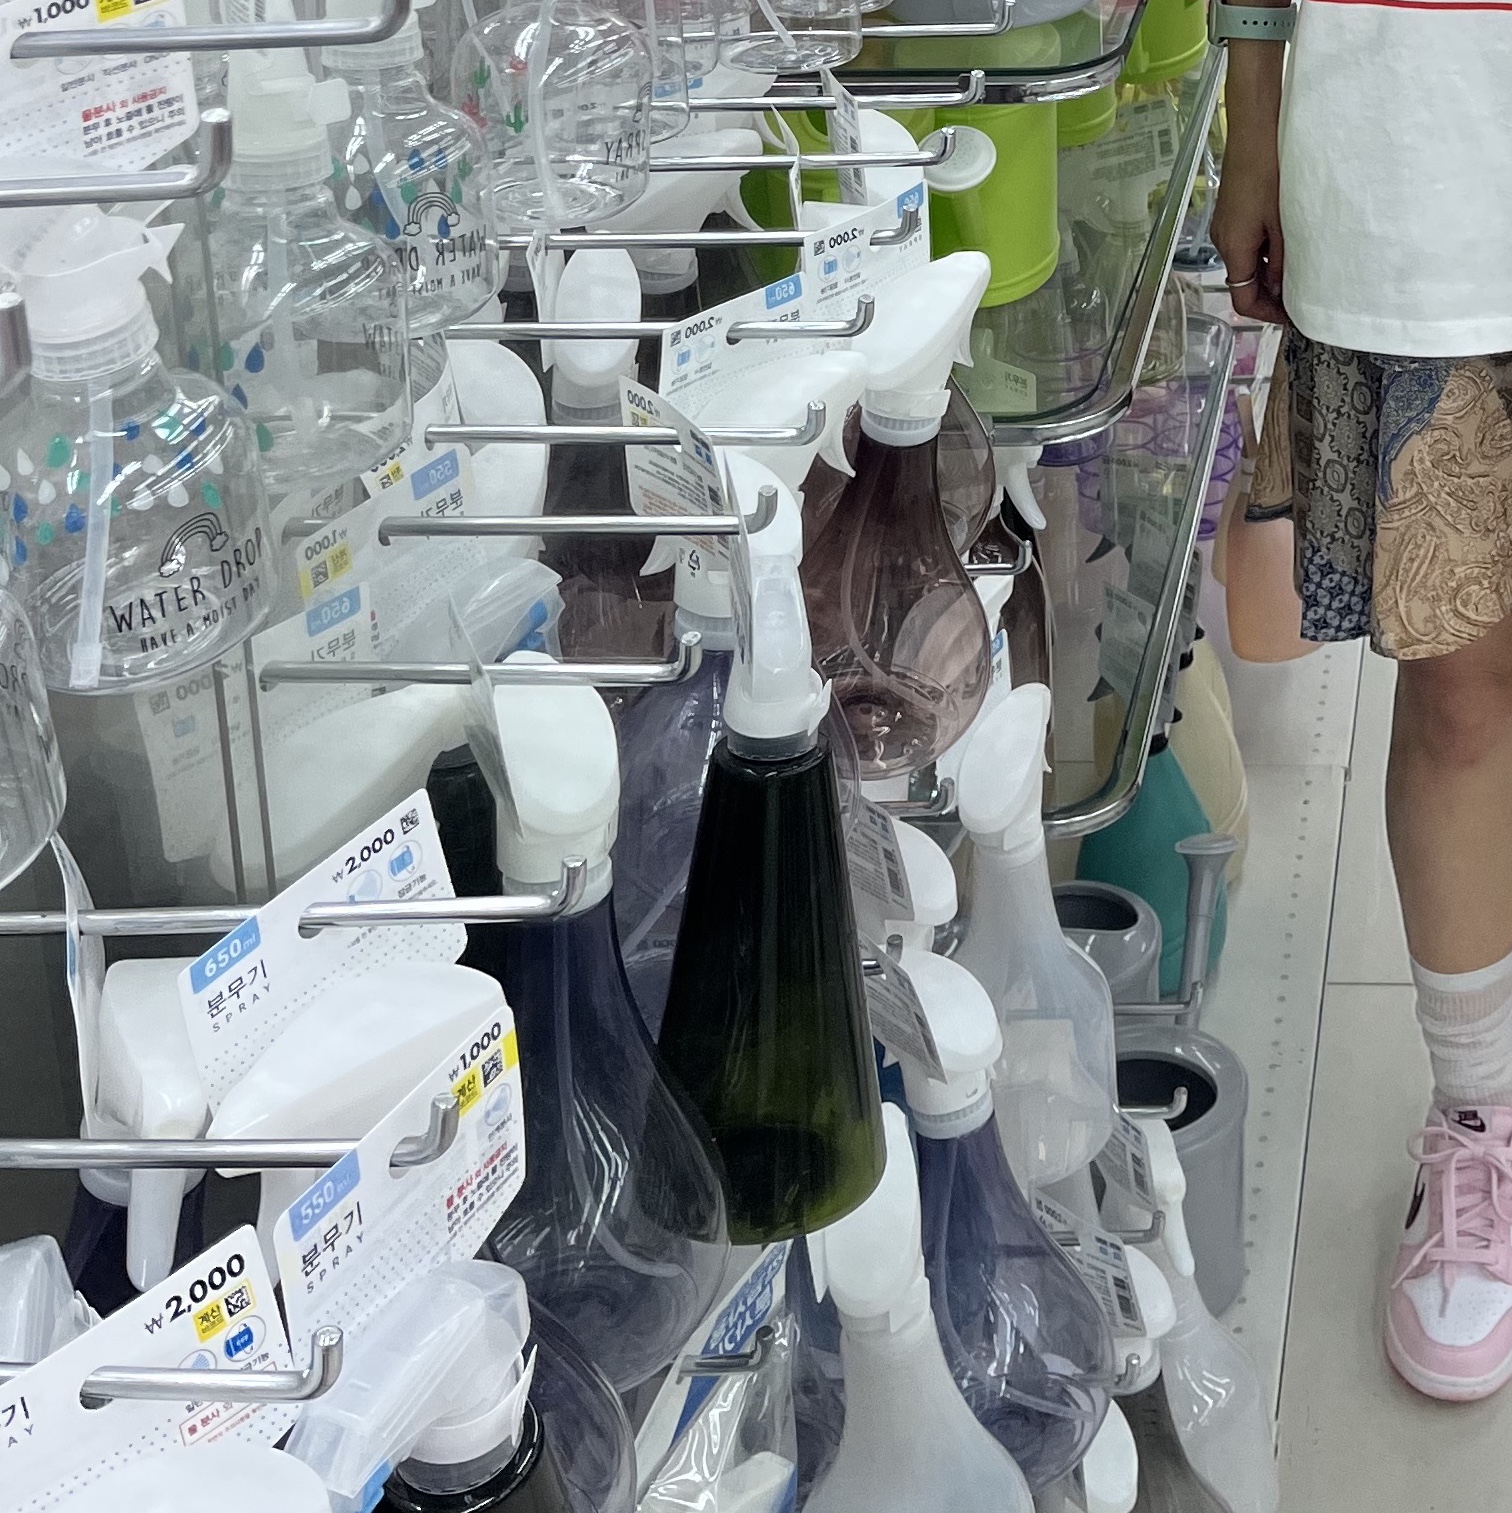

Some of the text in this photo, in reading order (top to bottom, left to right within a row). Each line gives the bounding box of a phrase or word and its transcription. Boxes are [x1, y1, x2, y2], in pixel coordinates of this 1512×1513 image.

[108, 526, 264, 635] WATER DROP
[140, 625, 180, 655] HAVE
[186, 622, 195, 637] A
[202, 594, 240, 630] MOIST
[331, 828, 396, 884] ₩2,000
[206, 959, 268, 1019] 분무기
[212, 982, 271, 1033] SPRAY
[448, 1021, 502, 1083] ₩1,000
[301, 1200, 363, 1278] 분무기
[306, 1231, 364, 1295] SPRAY
[144, 1253, 246, 1335] ₩2,000
